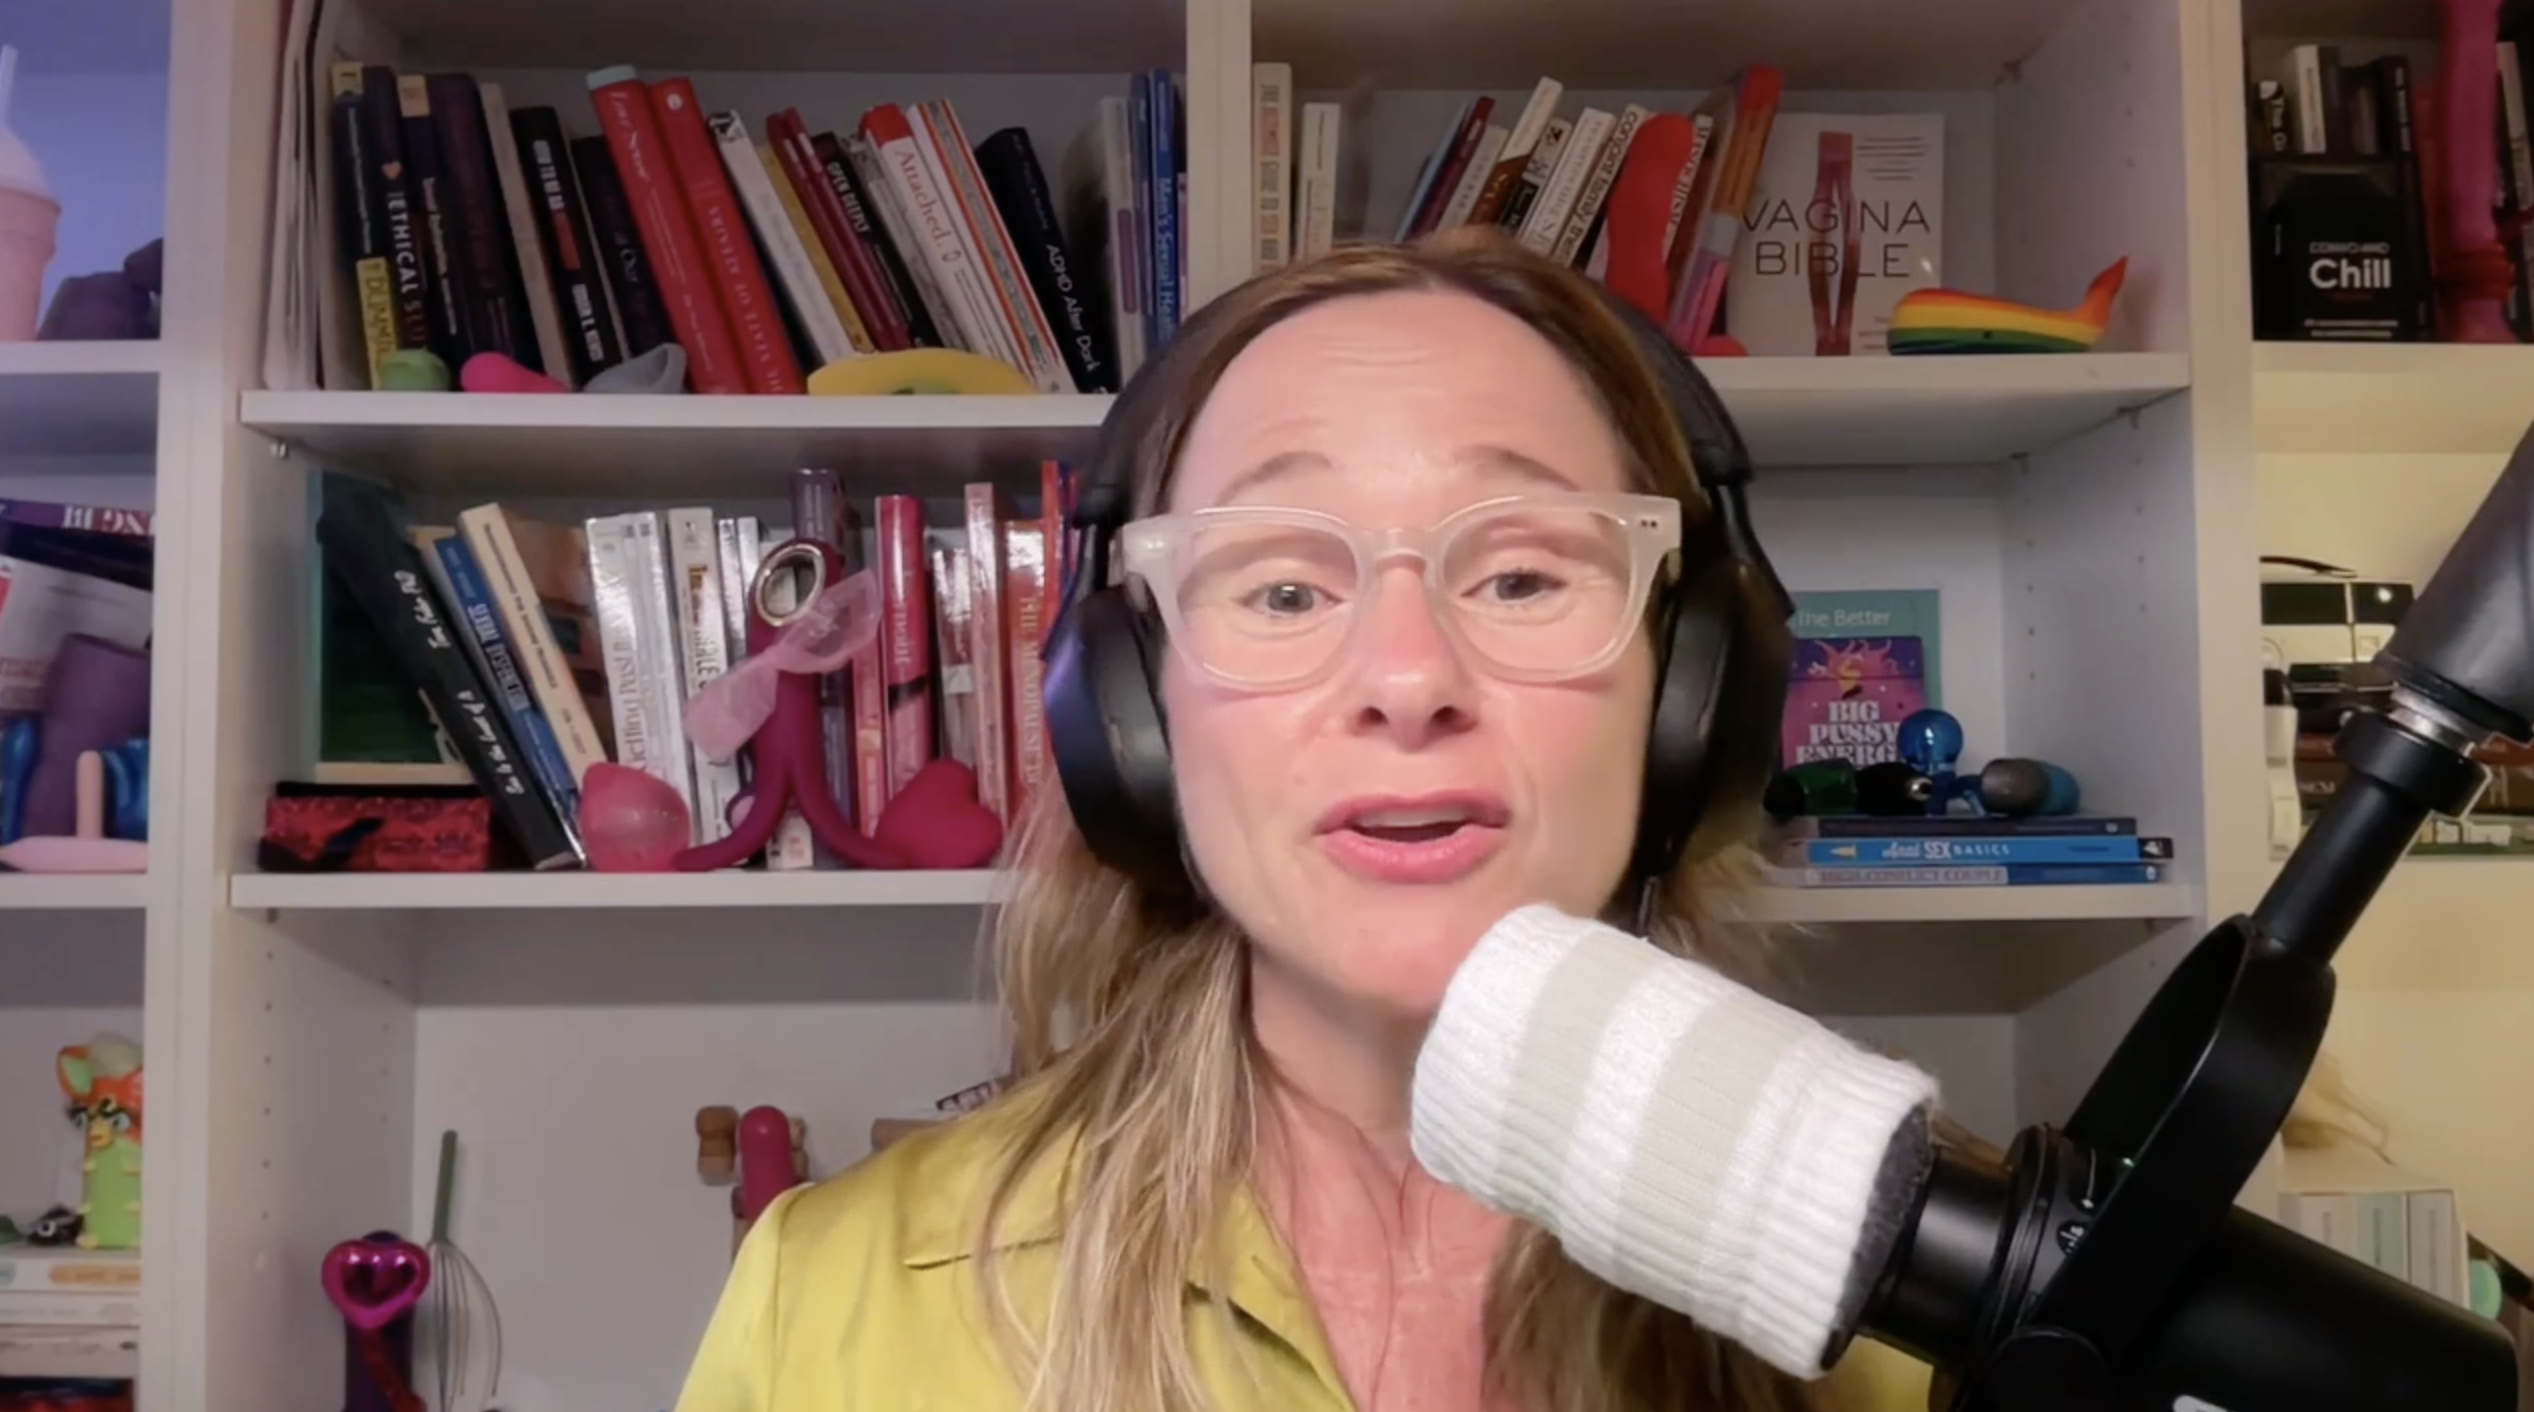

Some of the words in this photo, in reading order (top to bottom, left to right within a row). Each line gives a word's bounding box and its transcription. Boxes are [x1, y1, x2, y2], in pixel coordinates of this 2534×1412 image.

[827, 160, 851, 193] OPEN
[895, 148, 949, 247] Attached.
[1155, 177, 1173, 224] Men's
[1742, 199, 1931, 233] VAGINA
[388, 198, 420, 294] ETHICAL
[705, 205, 746, 276] AFFAIRS
[1157, 230, 1174, 286] Sexual
[1045, 243, 1075, 293] ADHD
[1756, 242, 1911, 278] BIBLE
[2309, 258, 2391, 288] Chill
[732, 280, 753, 307] OF
[1063, 294, 1088, 335] After
[744, 311, 777, 362] STATE
[1075, 332, 1103, 372] Dark
[1799, 610, 1829, 627] The
[1833, 609, 1891, 628] Better
[1020, 640, 1043, 758] MENOPAUSE
[1829, 700, 1880, 722] BIG
[1810, 722, 1901, 744] PUSSY
[1796, 744, 1899, 768] ENERG
[1923, 839, 1952, 860] SEX
[1953, 842, 2011, 858] BASICS
